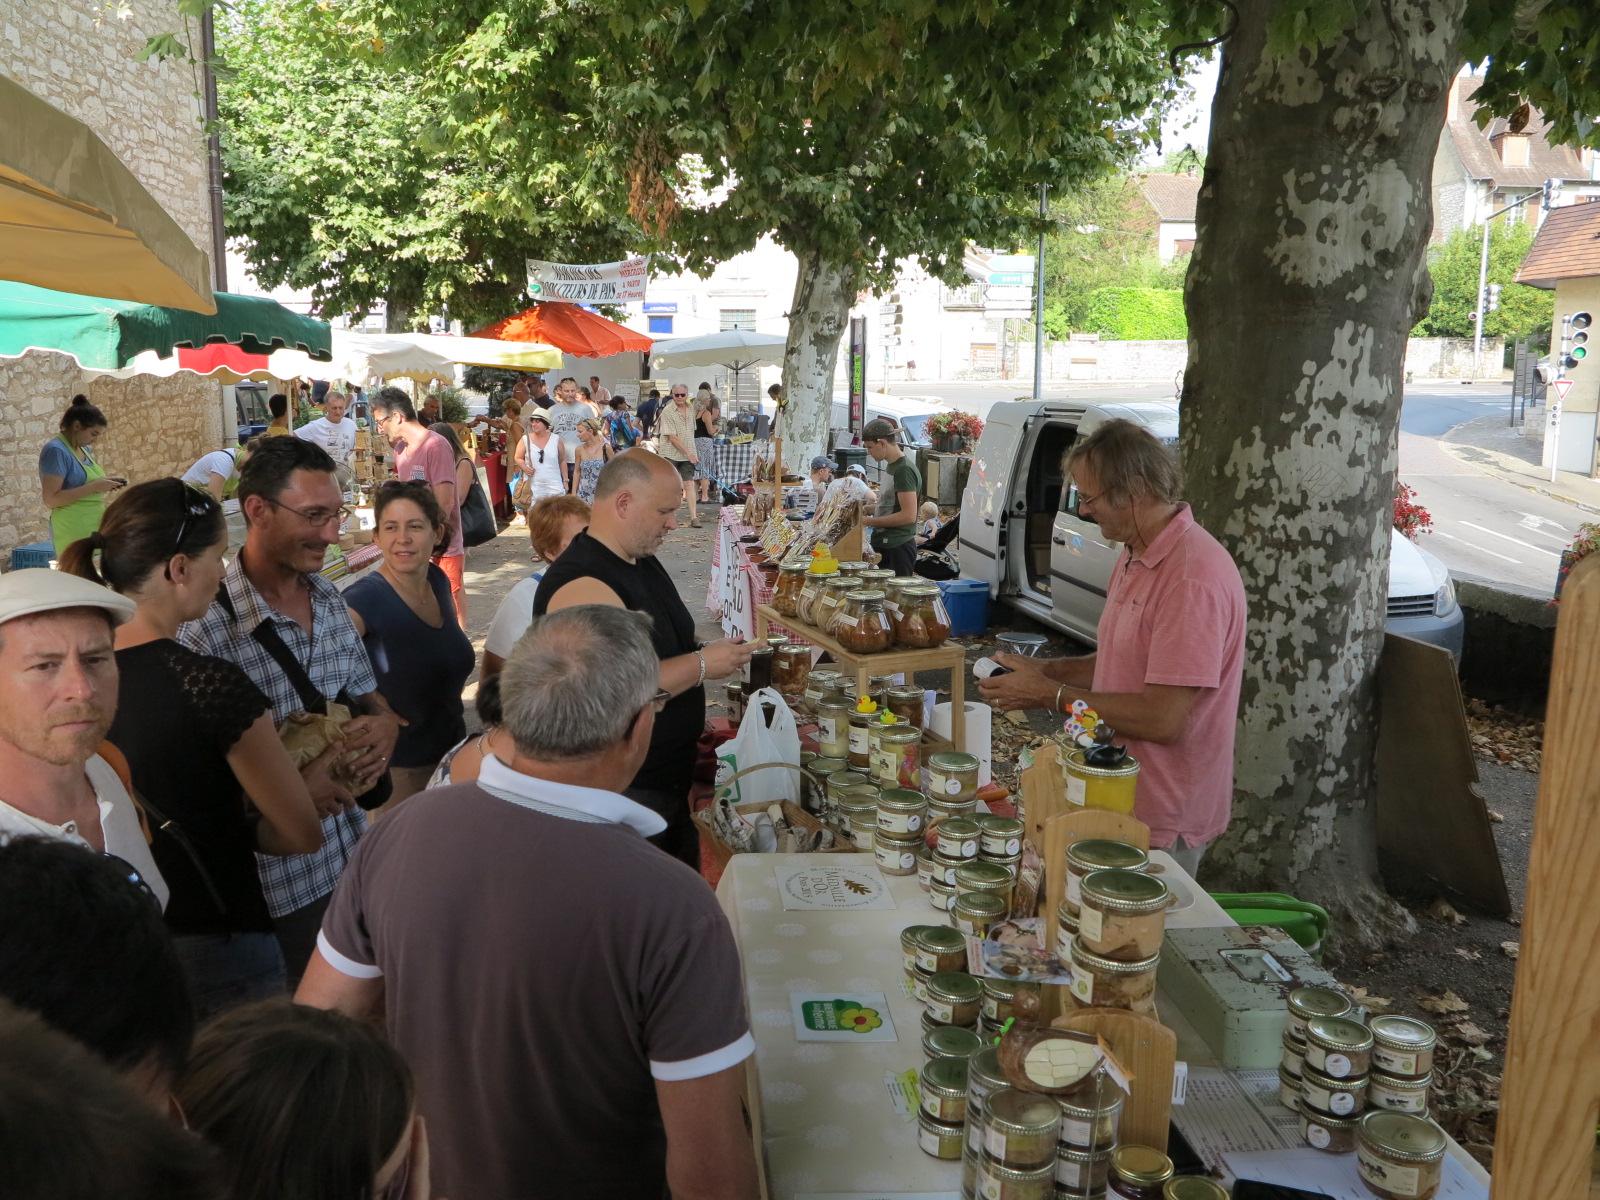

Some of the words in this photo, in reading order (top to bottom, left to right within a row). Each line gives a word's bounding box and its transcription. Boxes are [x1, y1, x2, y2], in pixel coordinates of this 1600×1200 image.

[585, 266, 602, 281] DES
[587, 283, 599, 299] DE
[599, 282, 616, 299] PAYS
[812, 1010, 826, 1029] ferme
